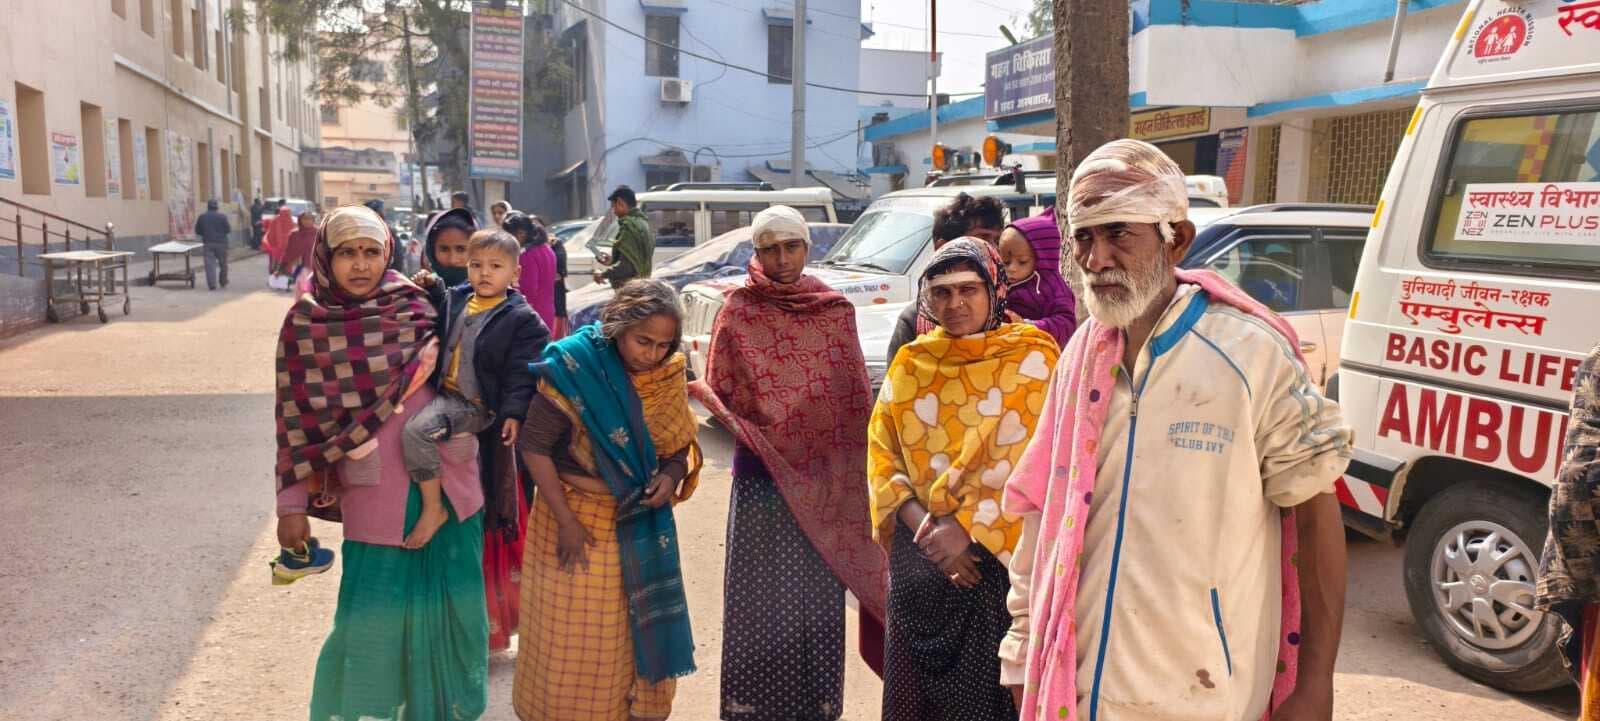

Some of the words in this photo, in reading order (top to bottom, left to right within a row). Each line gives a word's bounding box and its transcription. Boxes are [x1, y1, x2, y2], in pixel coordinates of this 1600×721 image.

[991, 60, 1010, 79] गहन
[1469, 191, 1535, 208] स्वास्थ्य
[1493, 214, 1536, 228] ZEN
[1540, 215, 1599, 229] PLUS
[1402, 276, 1456, 300] बुनियादी
[1400, 301, 1548, 335] एम्बुलेन्स
[1386, 333, 1488, 376] BASIC
[1499, 349, 1583, 392] LIFE
[1168, 421, 1200, 435] SPIRIT
[1202, 422, 1215, 435] OF
[1174, 437, 1203, 450] CLUB
